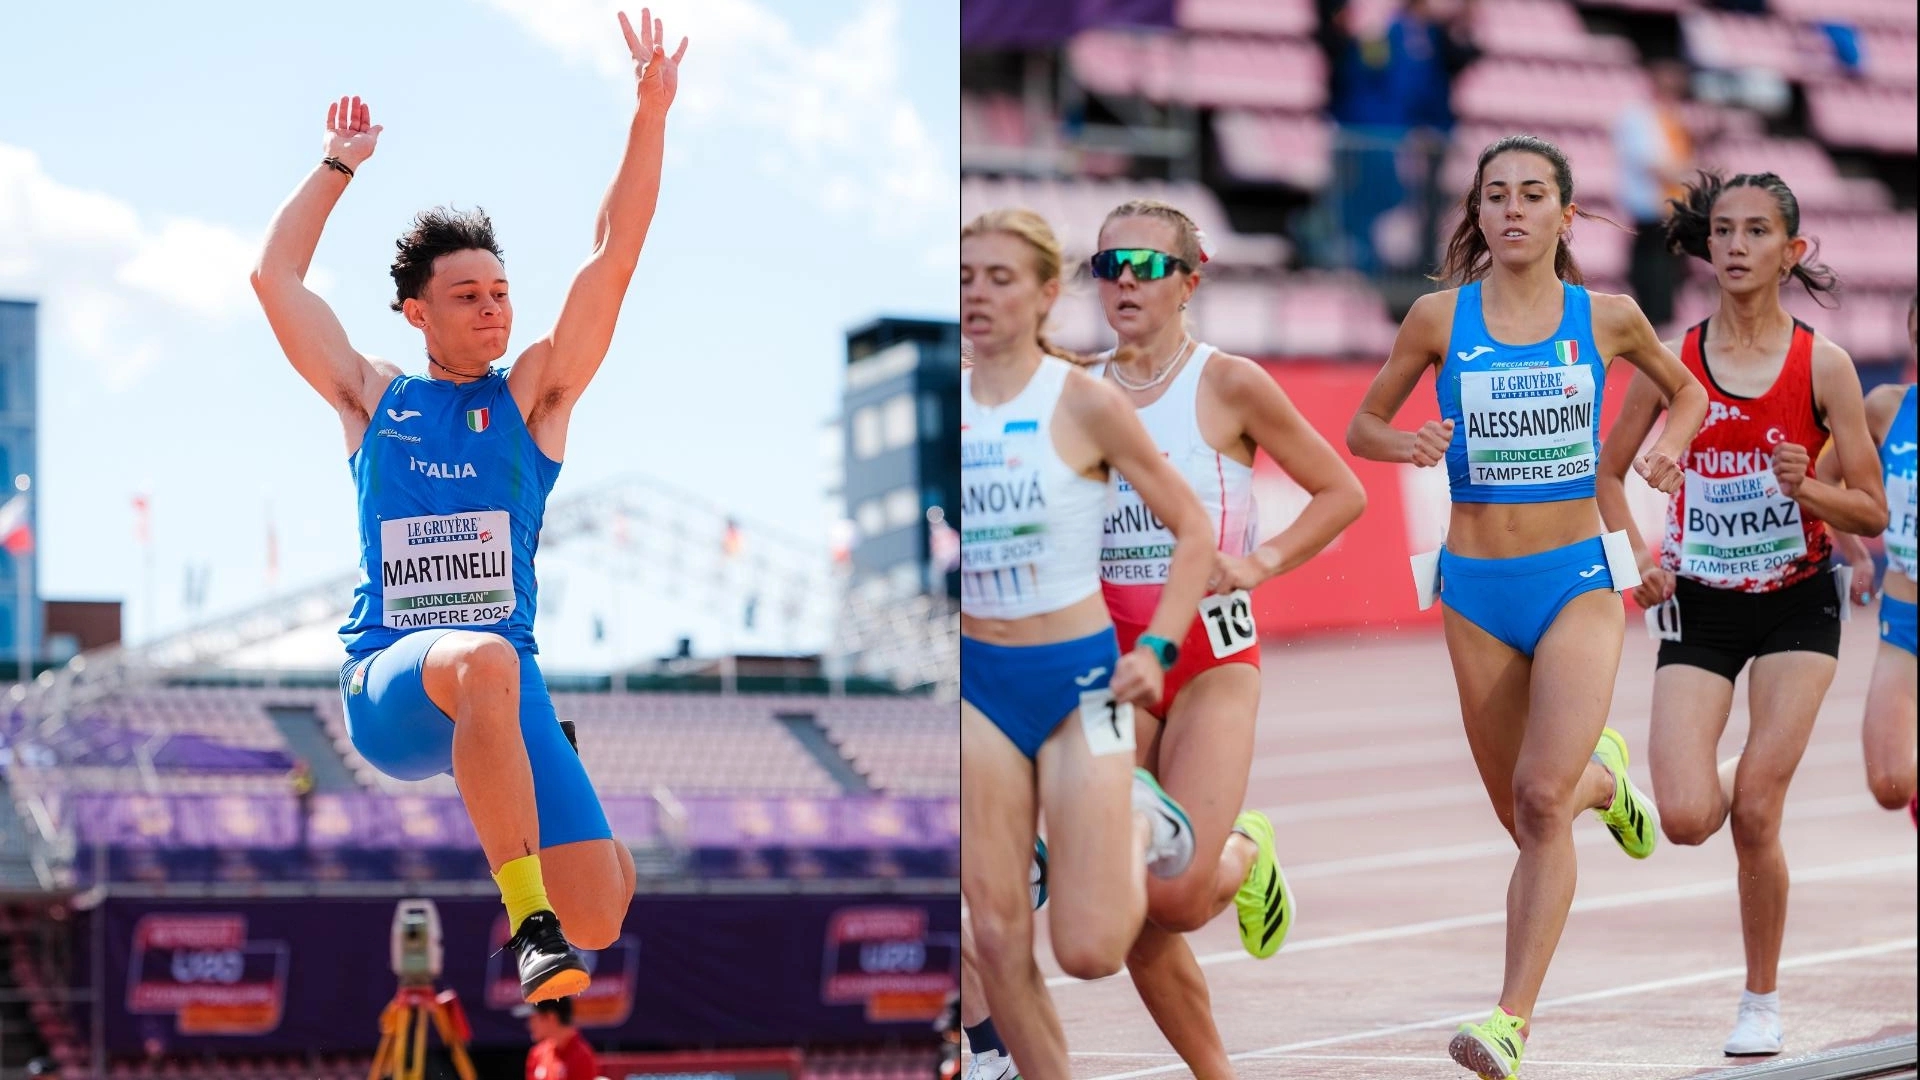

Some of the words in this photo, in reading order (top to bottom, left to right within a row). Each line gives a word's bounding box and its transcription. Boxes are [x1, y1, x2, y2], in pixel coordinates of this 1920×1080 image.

[1491, 360, 1550, 368] FRECCIAROSSA
[1490, 376, 1505, 391] LE
[1508, 371, 1563, 391] GRUYÈRE
[1494, 389, 1560, 399] SWITZERLAND
[1469, 402, 1591, 438] ALESSANDRINI
[1501, 451, 1526, 461] RUN
[410, 456, 477, 478] ITALIA
[1476, 465, 1553, 481] TAMPERE
[1557, 459, 1590, 477] 2025
[407, 523, 421, 537] LE
[423, 516, 478, 535] GRUYÈRE
[1688, 501, 1798, 537] BOYRAZ
[410, 534, 477, 545] SWITZERLAND
[1128, 545, 1169, 558] CLEAN
[383, 551, 506, 588] MARTINELLI
[1102, 564, 1154, 579] MPERE
[1688, 560, 1760, 575] TAMPERE
[411, 598, 415, 608] I
[417, 595, 443, 607] RUN
[391, 610, 470, 627] TAMPERE
[473, 606, 510, 621] 2025
[1208, 598, 1253, 647] 10
